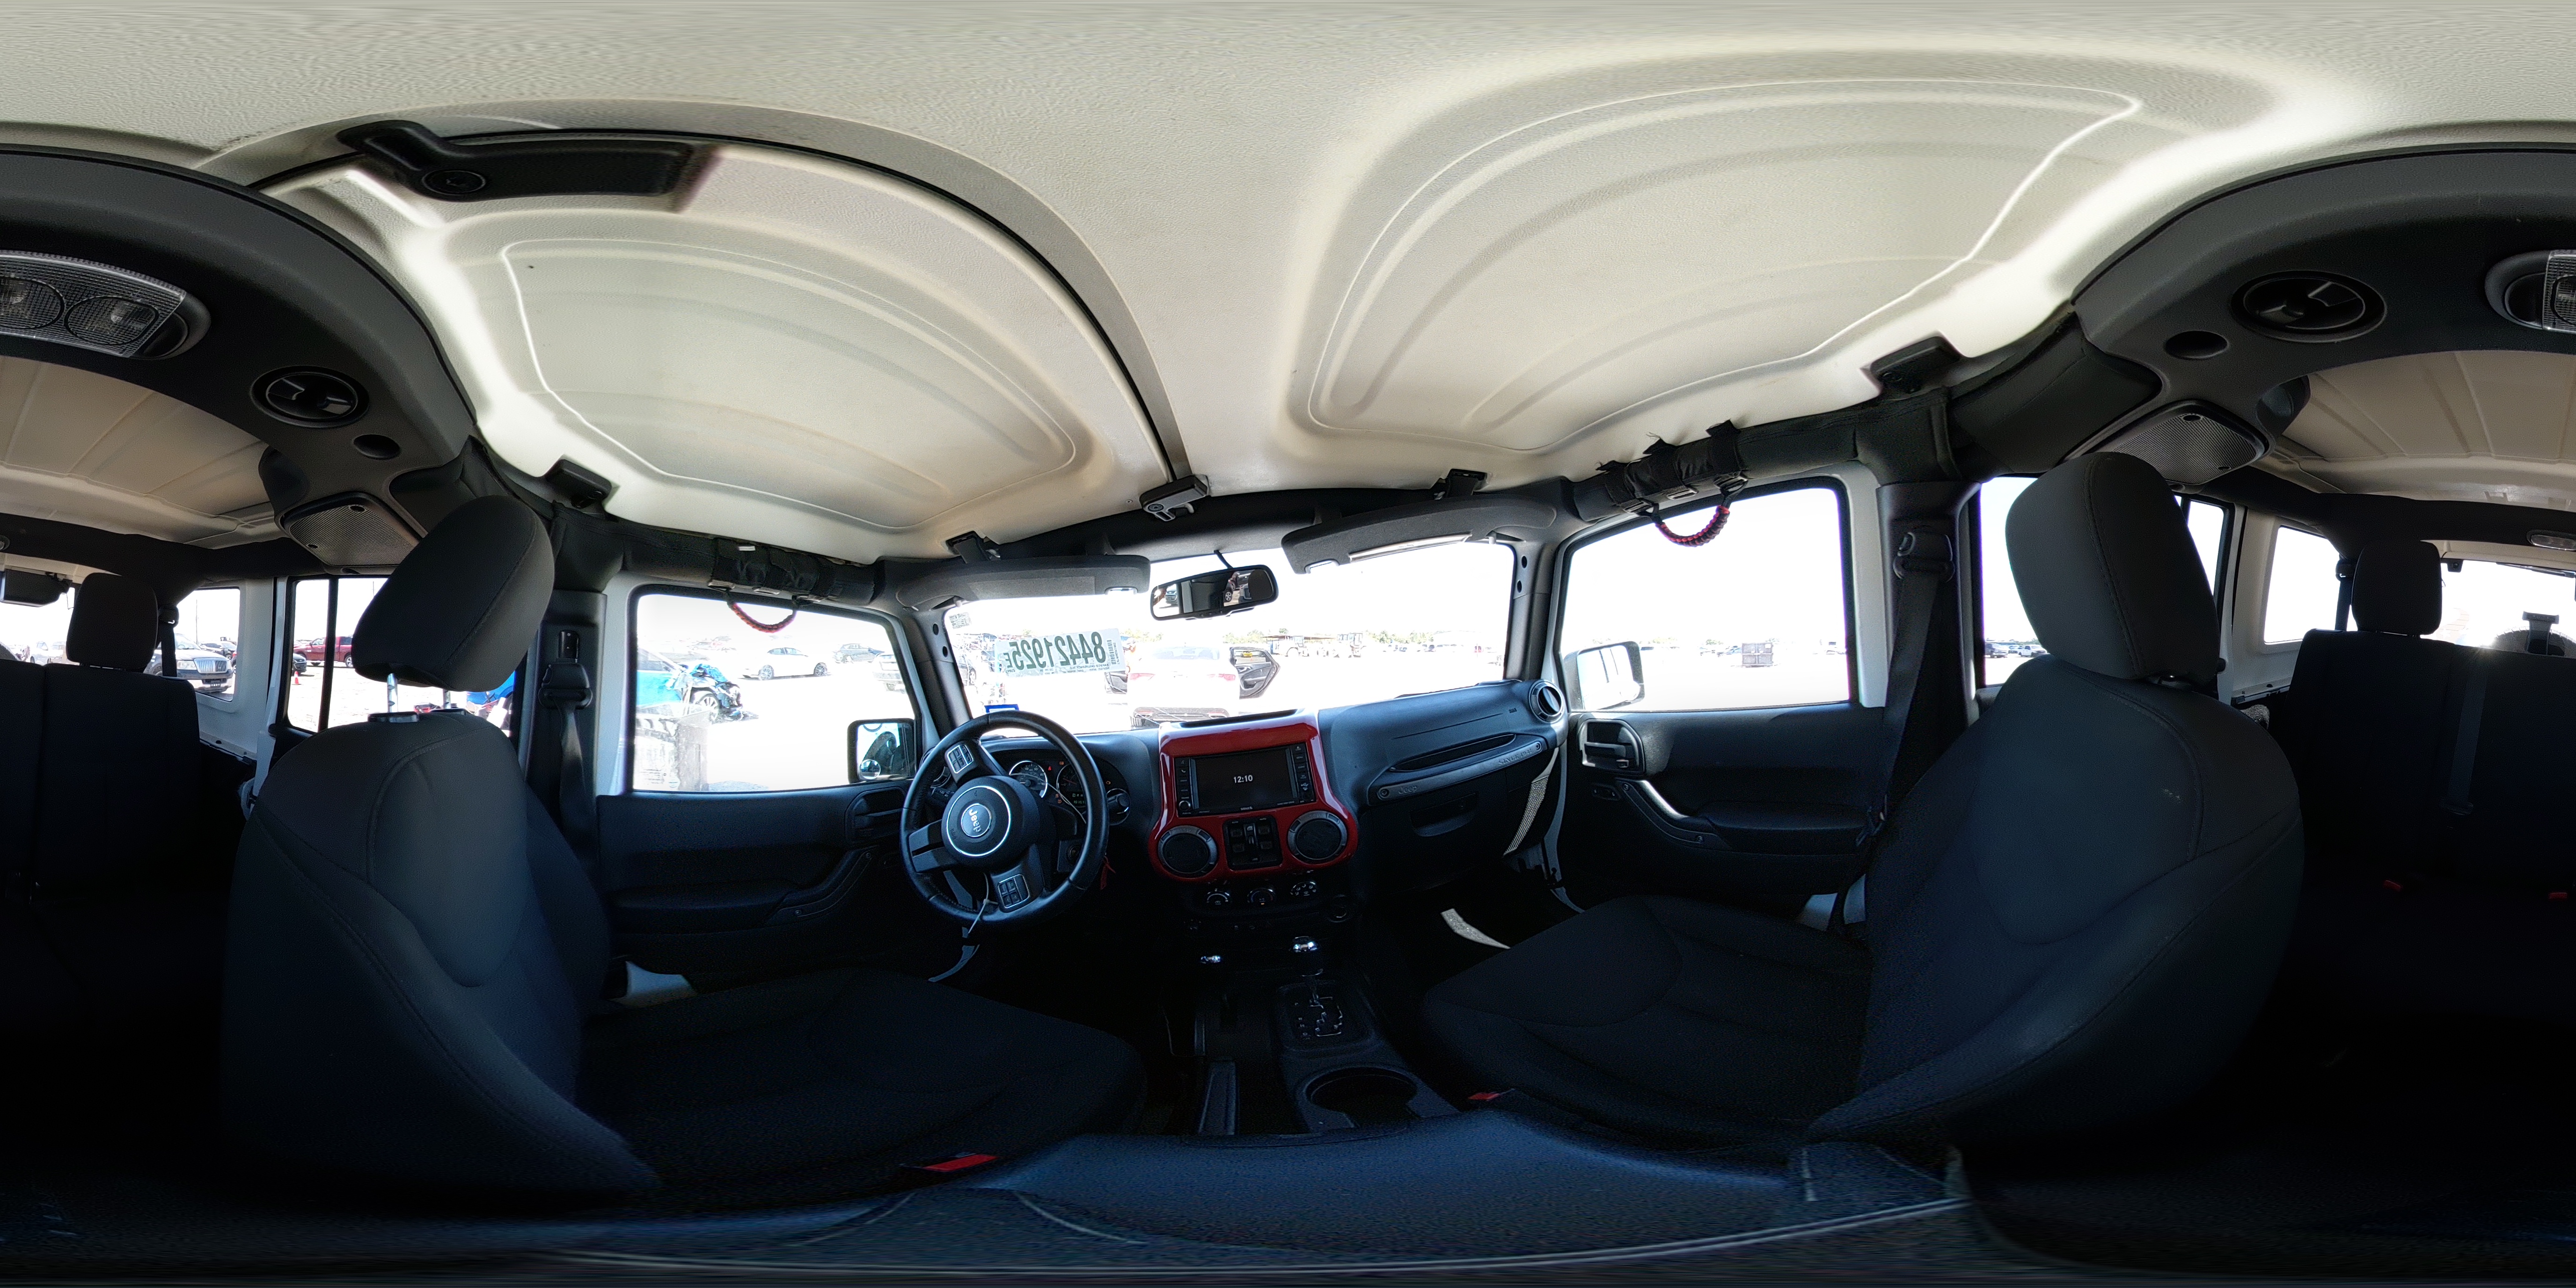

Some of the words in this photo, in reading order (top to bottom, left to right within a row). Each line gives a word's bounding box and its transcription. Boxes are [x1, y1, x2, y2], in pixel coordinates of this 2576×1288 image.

[1233, 775, 1253, 783] 12:10
[1398, 785, 1417, 794] Jeep
[969, 809, 982, 833] Jeep
